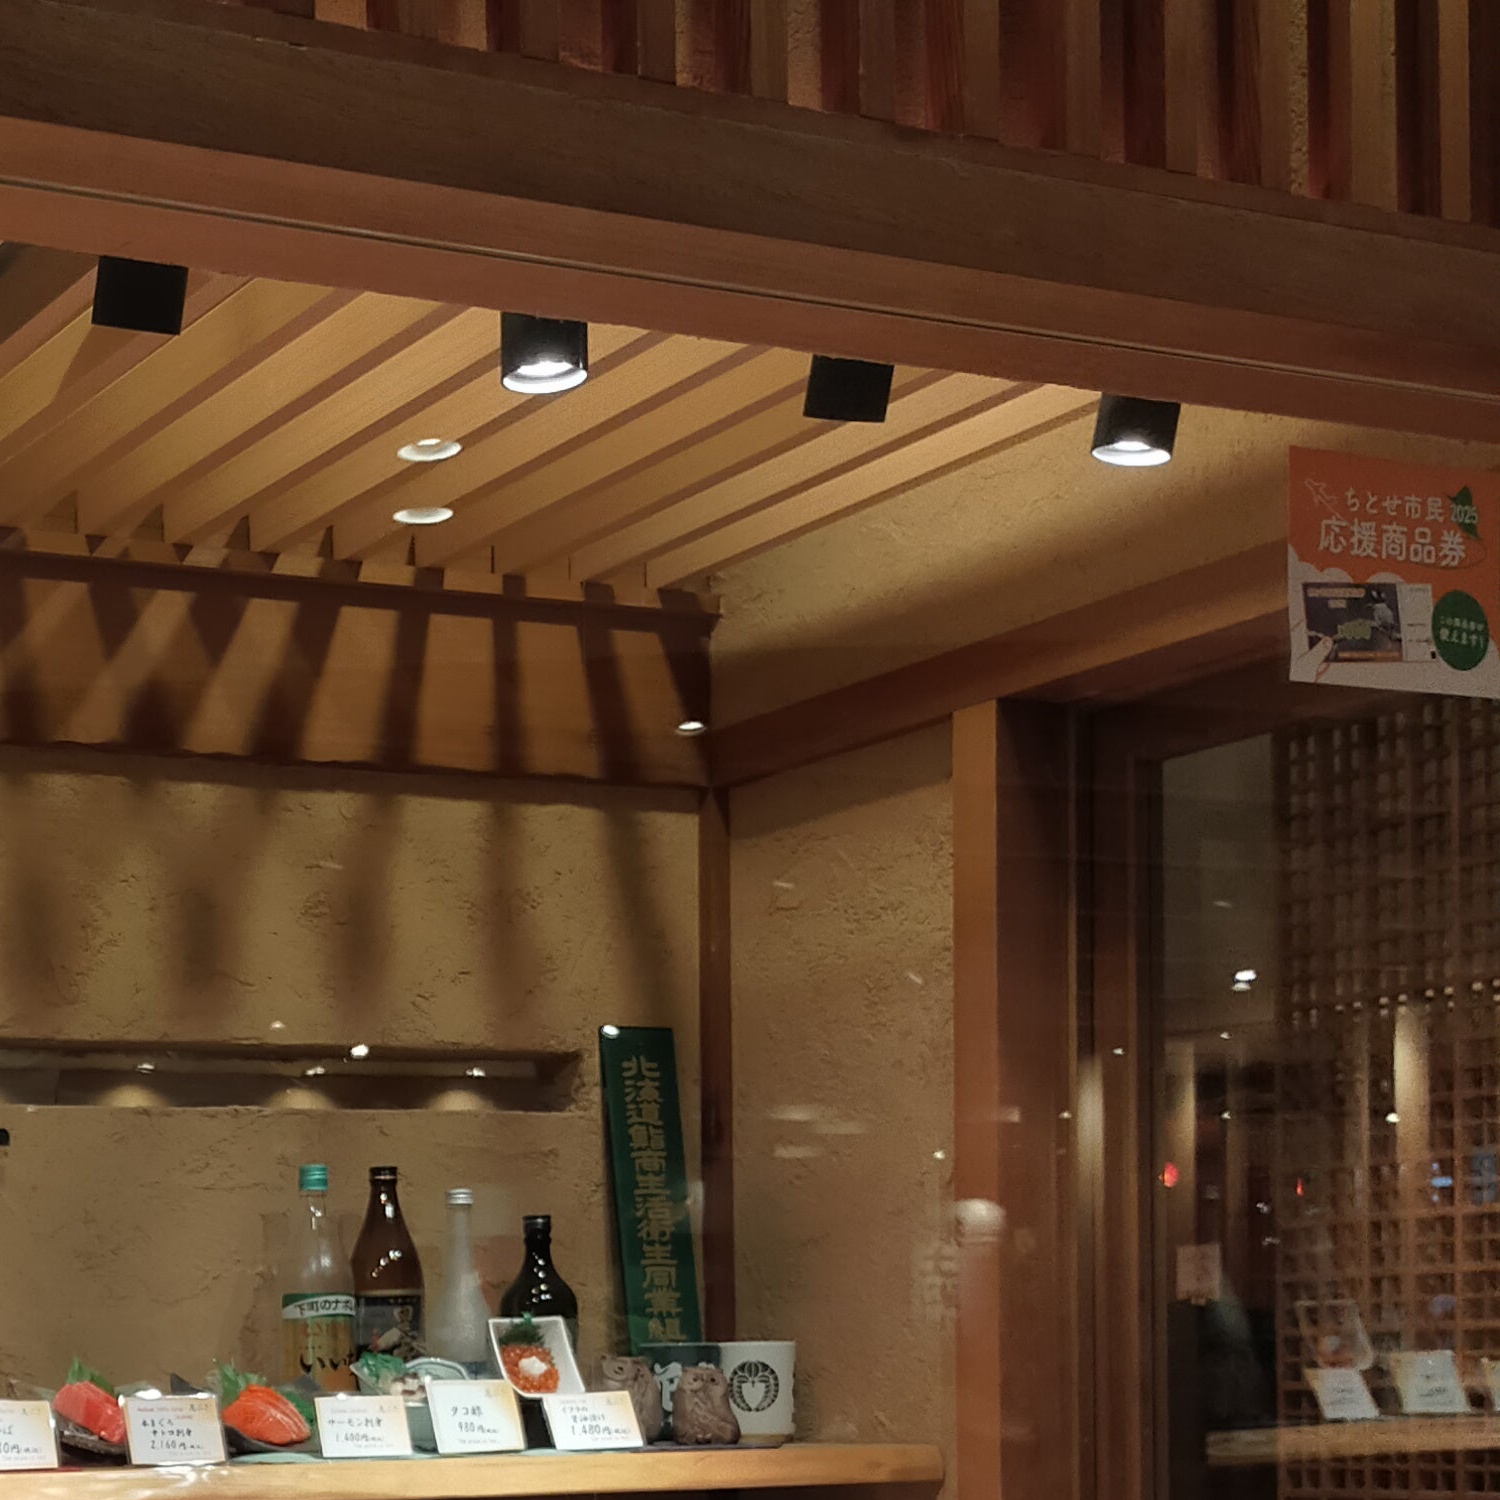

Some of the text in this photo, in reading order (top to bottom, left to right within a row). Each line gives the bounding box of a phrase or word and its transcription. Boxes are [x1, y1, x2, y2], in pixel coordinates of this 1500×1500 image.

[1345, 487, 1444, 522] ちとせ市民
[1450, 503, 1479, 525] 2025
[1317, 515, 1466, 567] 応援商品券
